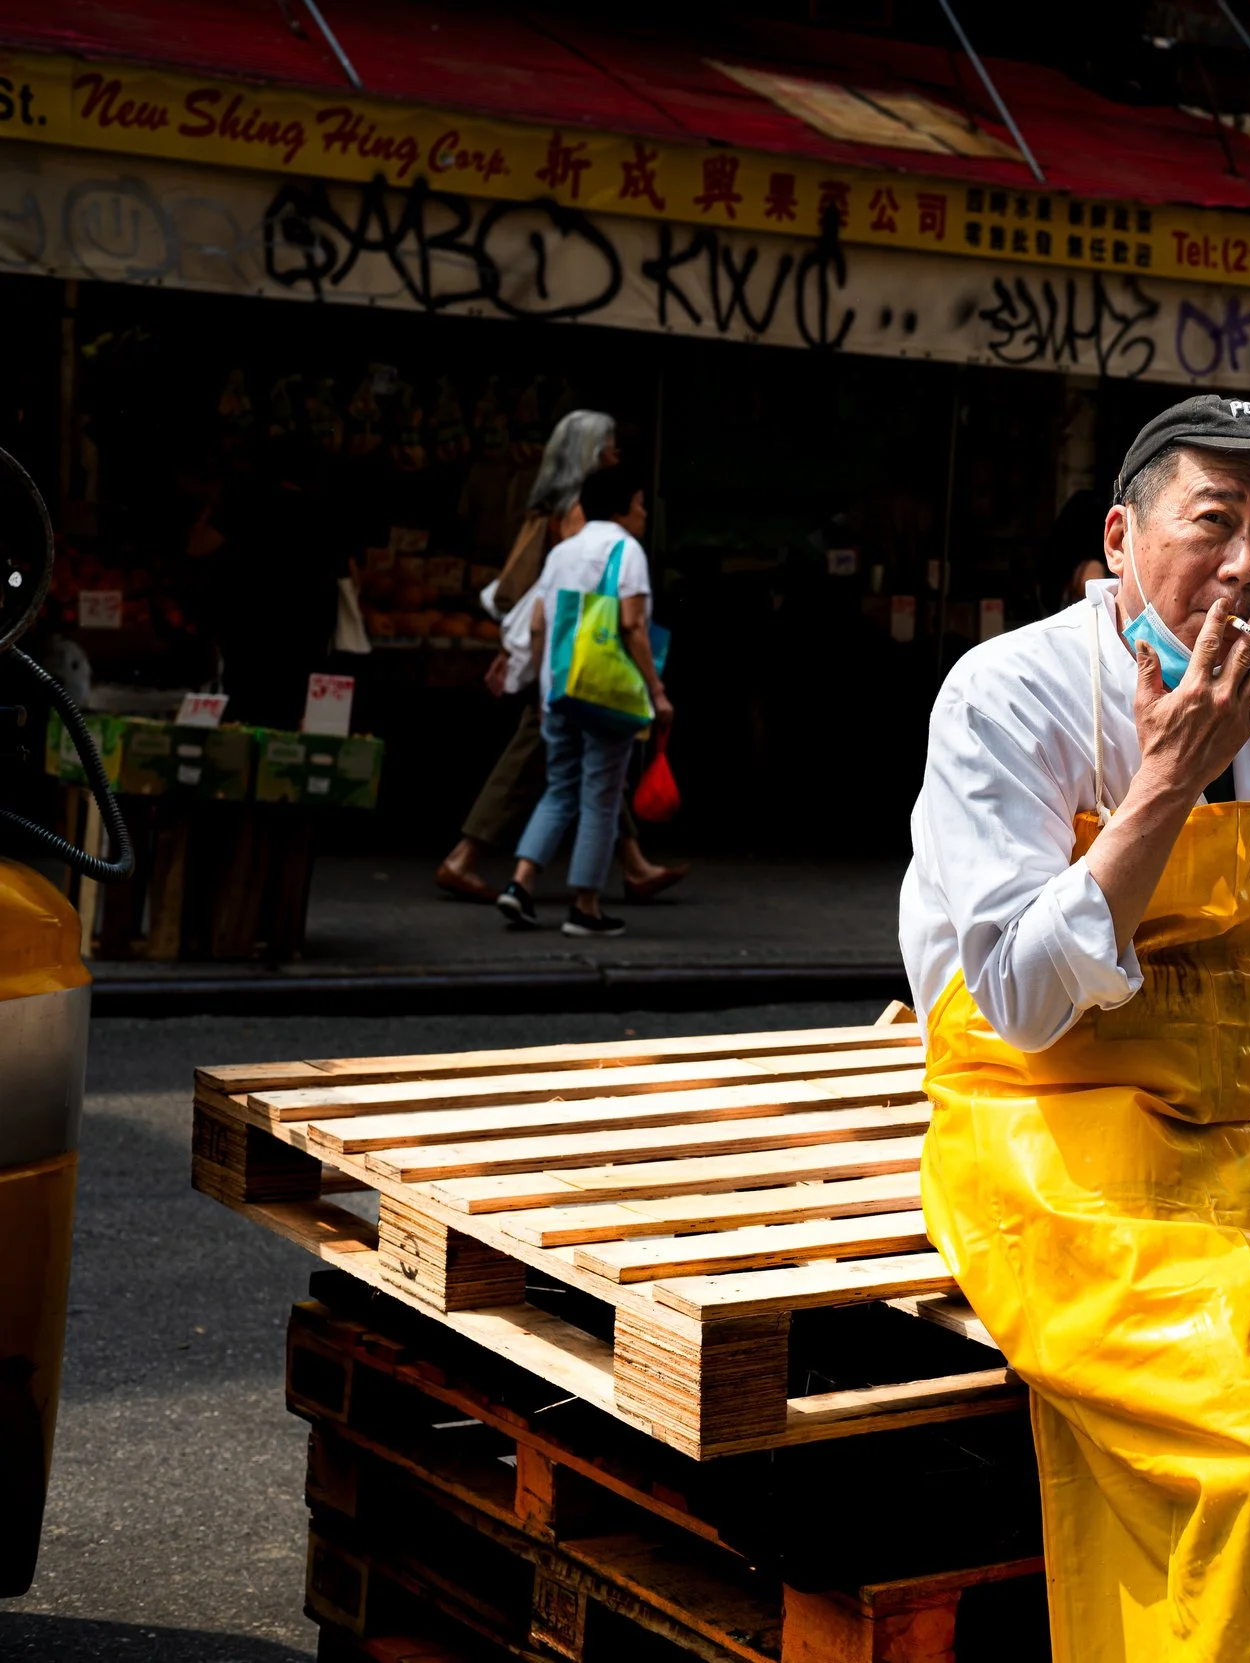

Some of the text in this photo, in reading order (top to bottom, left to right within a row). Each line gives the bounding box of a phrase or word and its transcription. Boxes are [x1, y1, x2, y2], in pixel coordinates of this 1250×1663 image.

[73, 73, 169, 127] New
[179, 88, 307, 164] Shing
[317, 107, 419, 179] Hing
[429, 130, 511, 182] Corp.
